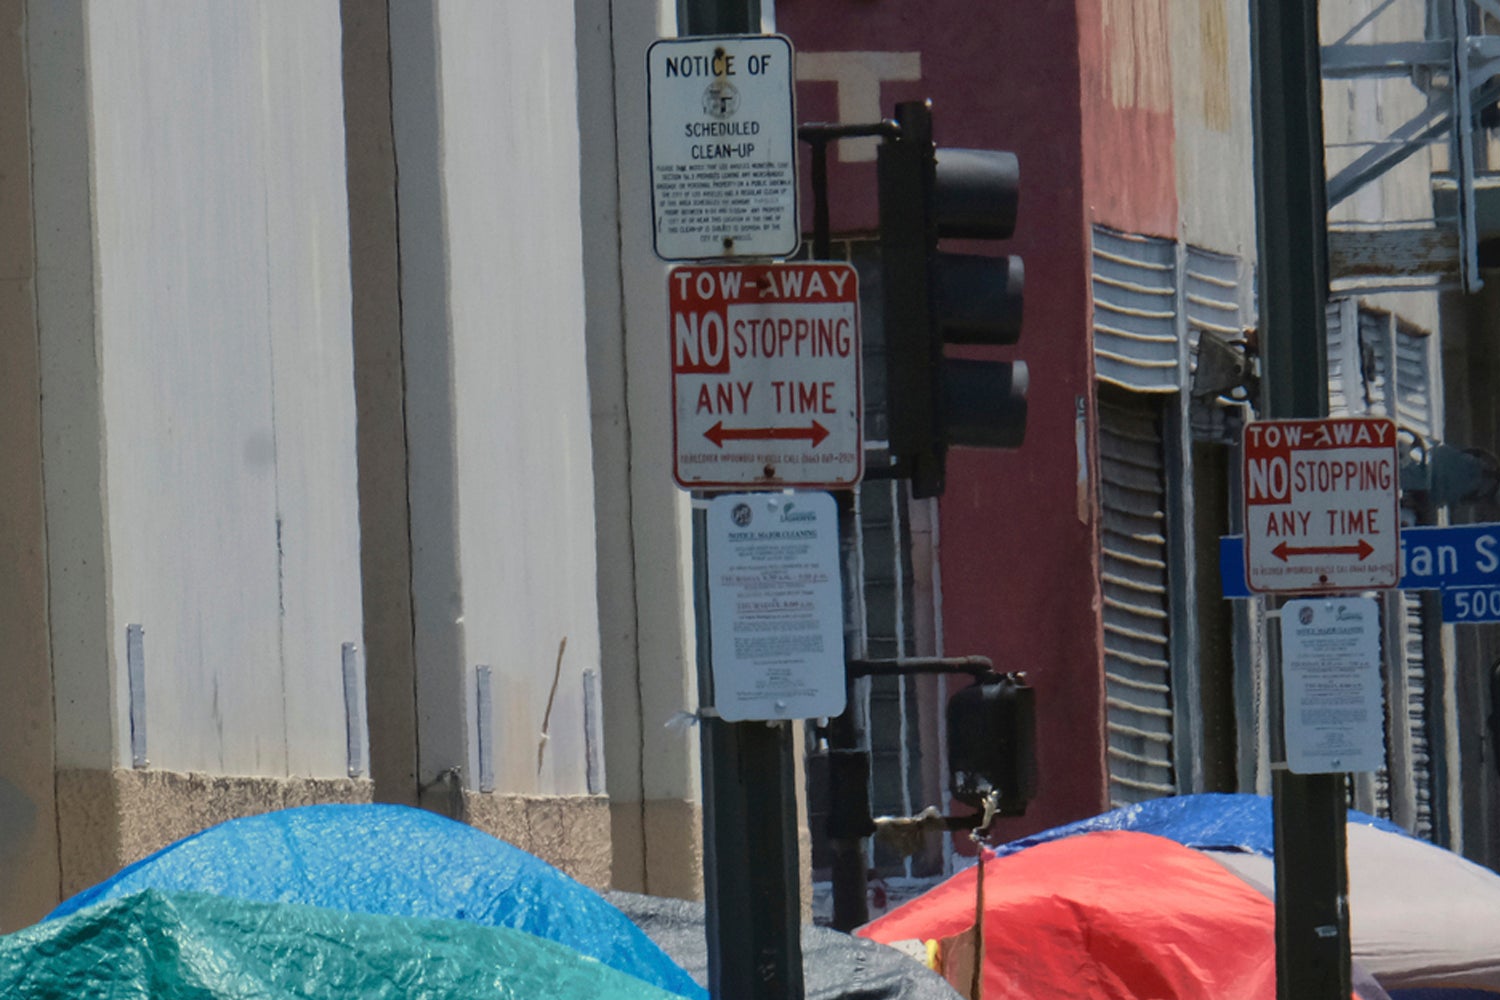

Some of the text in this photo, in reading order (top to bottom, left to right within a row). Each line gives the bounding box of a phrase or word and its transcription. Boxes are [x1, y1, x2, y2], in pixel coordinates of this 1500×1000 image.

[666, 55, 771, 77] NOTICE OF
[685, 122, 759, 138] SCHEDULED
[691, 144, 755, 159] CLEAN-UP
[674, 271, 849, 299] TOW-AWAY
[675, 311, 850, 367] NO STOPPING
[696, 382, 836, 414] ANY TIME
[1250, 423, 1390, 447] TOW-AWAY
[1249, 456, 1391, 500] NO STOPPING
[1266, 508, 1380, 537] ANY TIME
